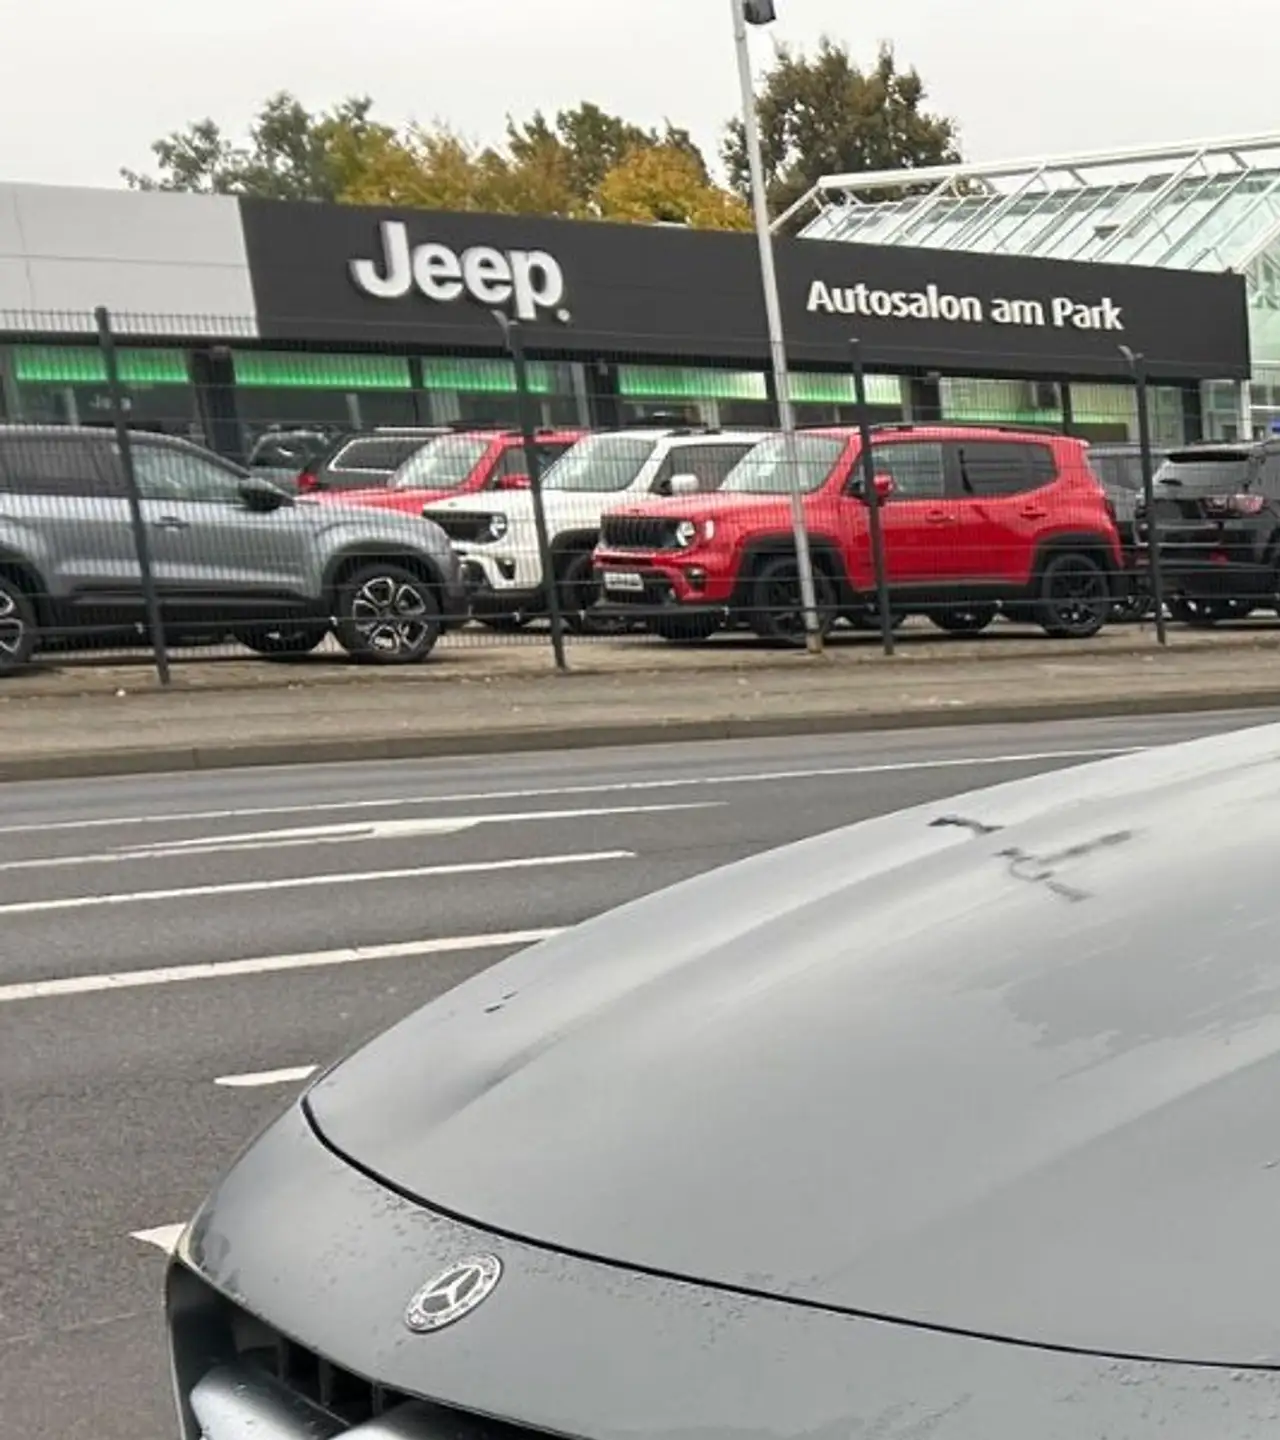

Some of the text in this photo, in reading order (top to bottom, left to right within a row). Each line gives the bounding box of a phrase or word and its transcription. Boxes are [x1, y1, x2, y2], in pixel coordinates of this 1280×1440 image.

[349, 220, 564, 321] Jeep
[806, 280, 1124, 330] Autosalon am Park
